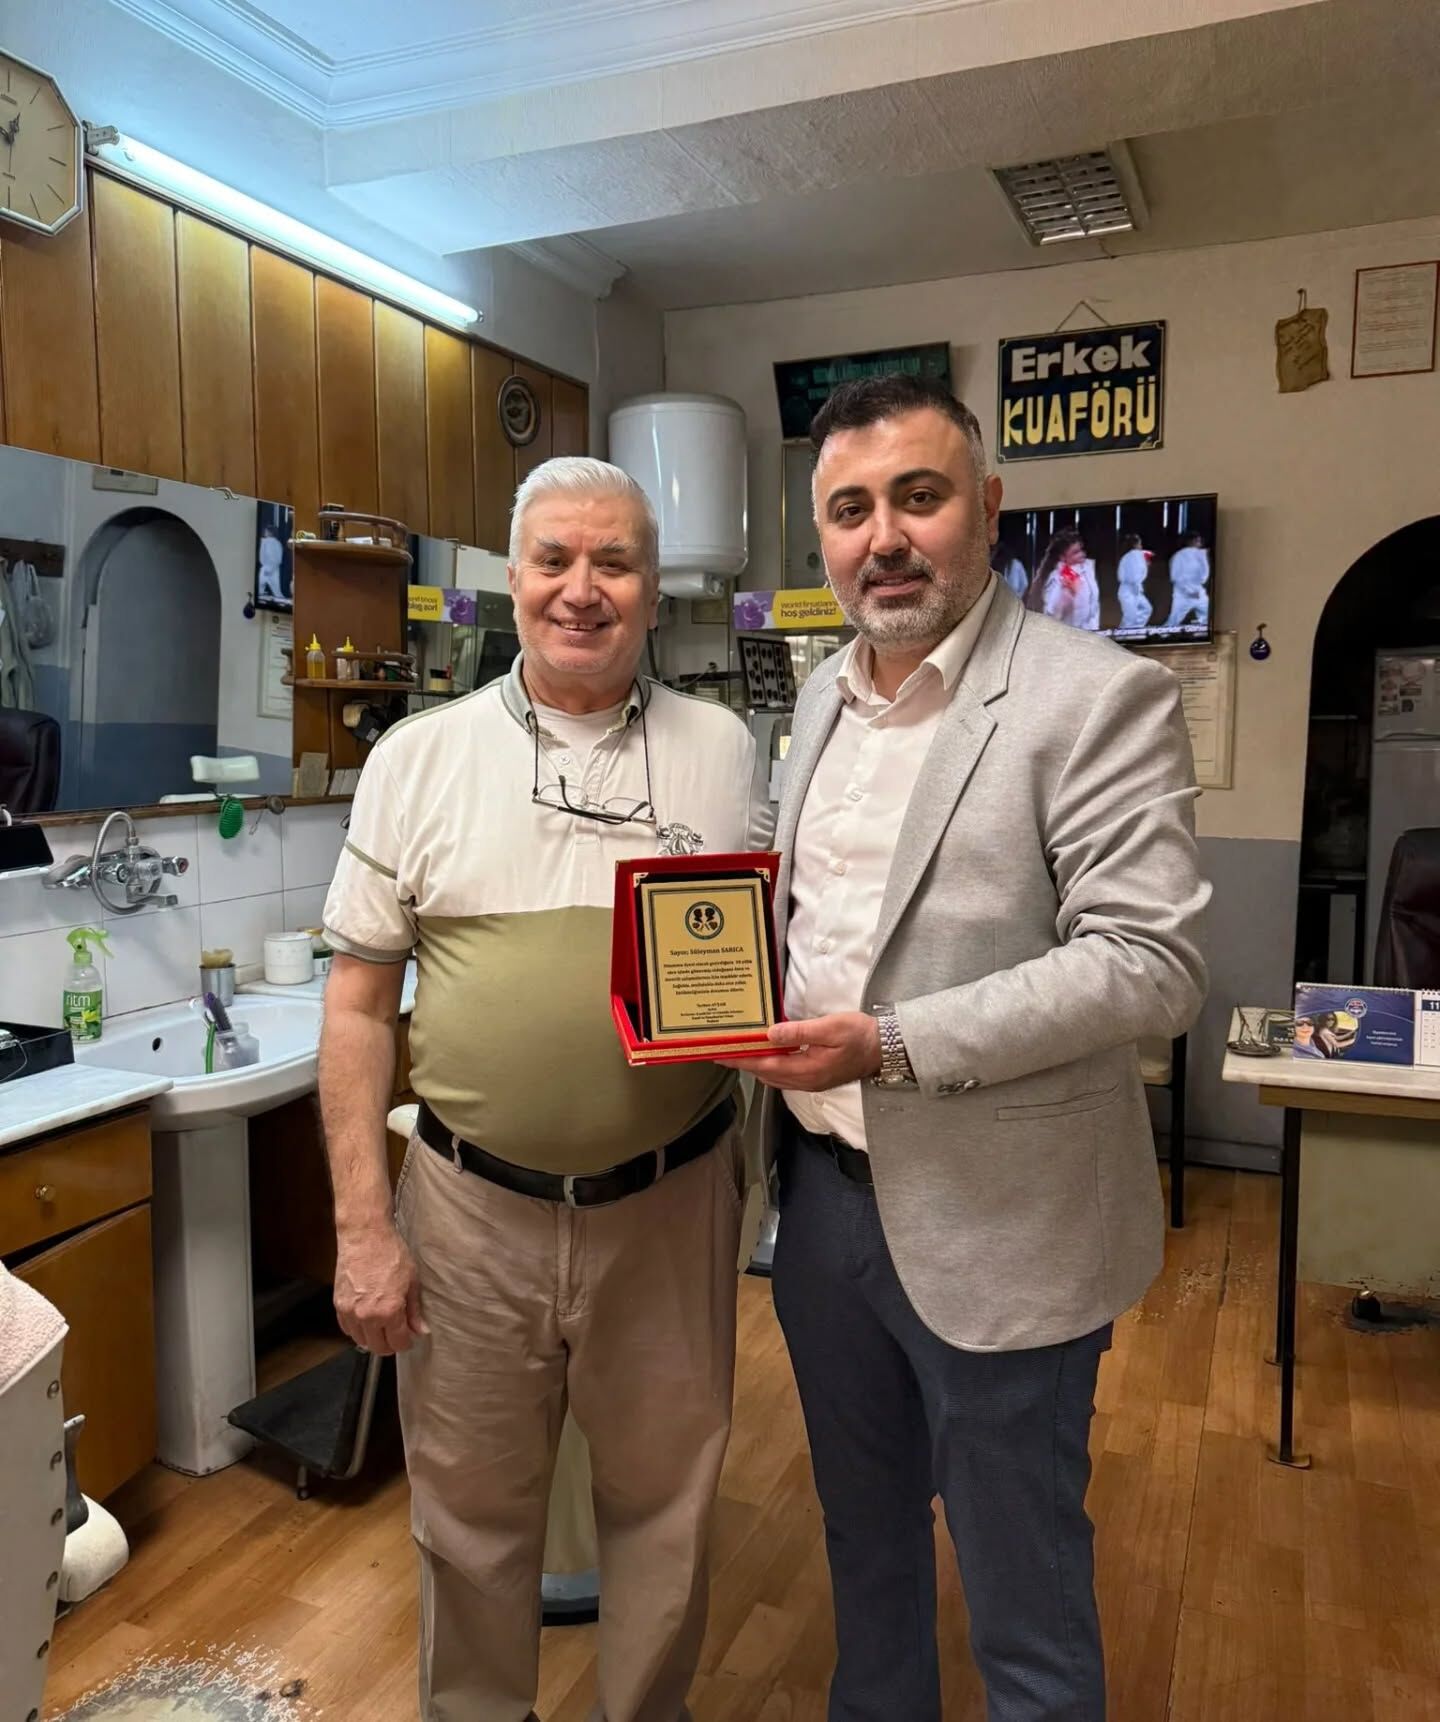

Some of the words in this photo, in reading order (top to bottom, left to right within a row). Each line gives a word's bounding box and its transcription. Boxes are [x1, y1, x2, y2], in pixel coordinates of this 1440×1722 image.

[1011, 335, 1152, 383] Erkek
[1003, 375, 1156, 448] KUAFÖRÜ
[780, 608, 798, 618] hoş
[799, 606, 836, 619] geldiniz!
[690, 947, 720, 956] Süleyman
[66, 993, 91, 1007] ritm
